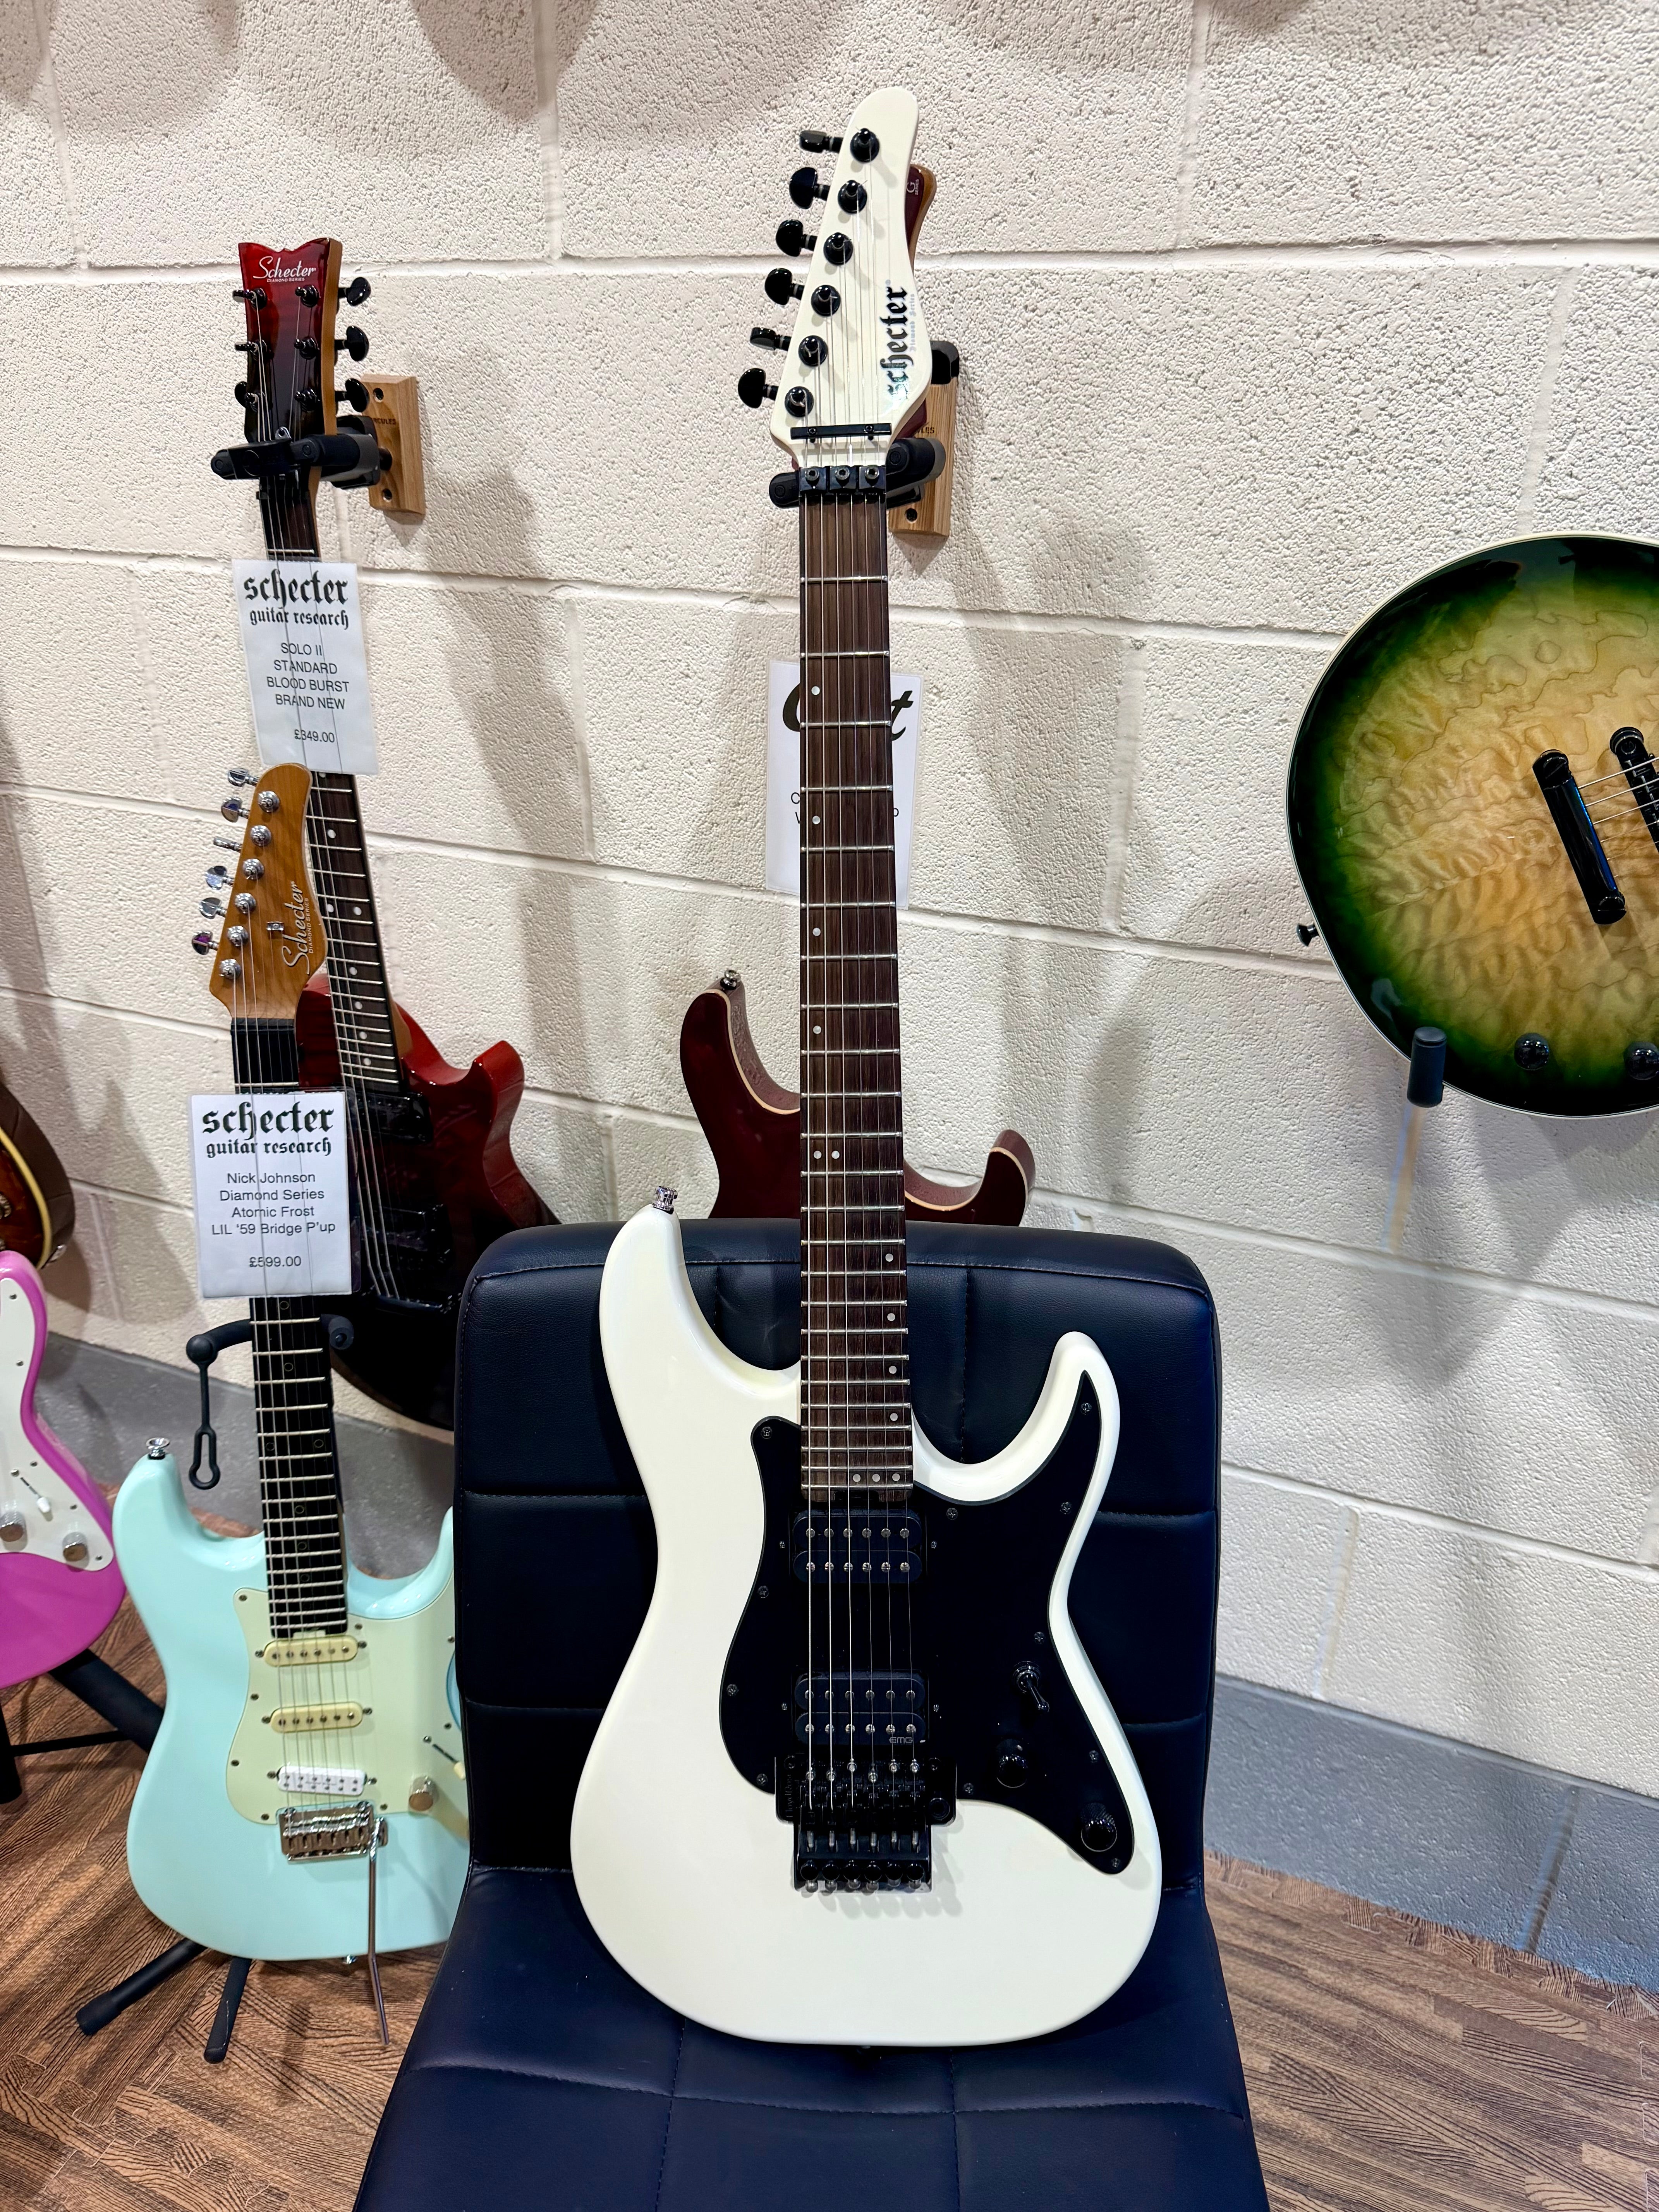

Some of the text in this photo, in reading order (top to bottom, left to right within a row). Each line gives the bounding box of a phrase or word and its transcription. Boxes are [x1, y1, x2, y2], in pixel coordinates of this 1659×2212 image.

[253, 256, 314, 278] Schecter
[244, 568, 348, 608] schecter
[250, 607, 349, 630] guitar research
[281, 642, 322, 656] SOLO II
[274, 660, 337, 674] STANDARD
[267, 677, 349, 692] BLOOD BURST
[275, 694, 345, 709] BRAND NEW
[282, 883, 310, 975] Schecter
[202, 1101, 334, 1140] schecter
[206, 1137, 331, 1158] guitar research
[227, 1173, 315, 1183] Nick Johnson
[220, 1189, 325, 1201] Diamond Series
[232, 1206, 315, 1218] Atomic Frost
[212, 1224, 233, 1235] LIL
[261, 1223, 302, 1236] Bridge
[249, 1255, 301, 1267] £599.00
